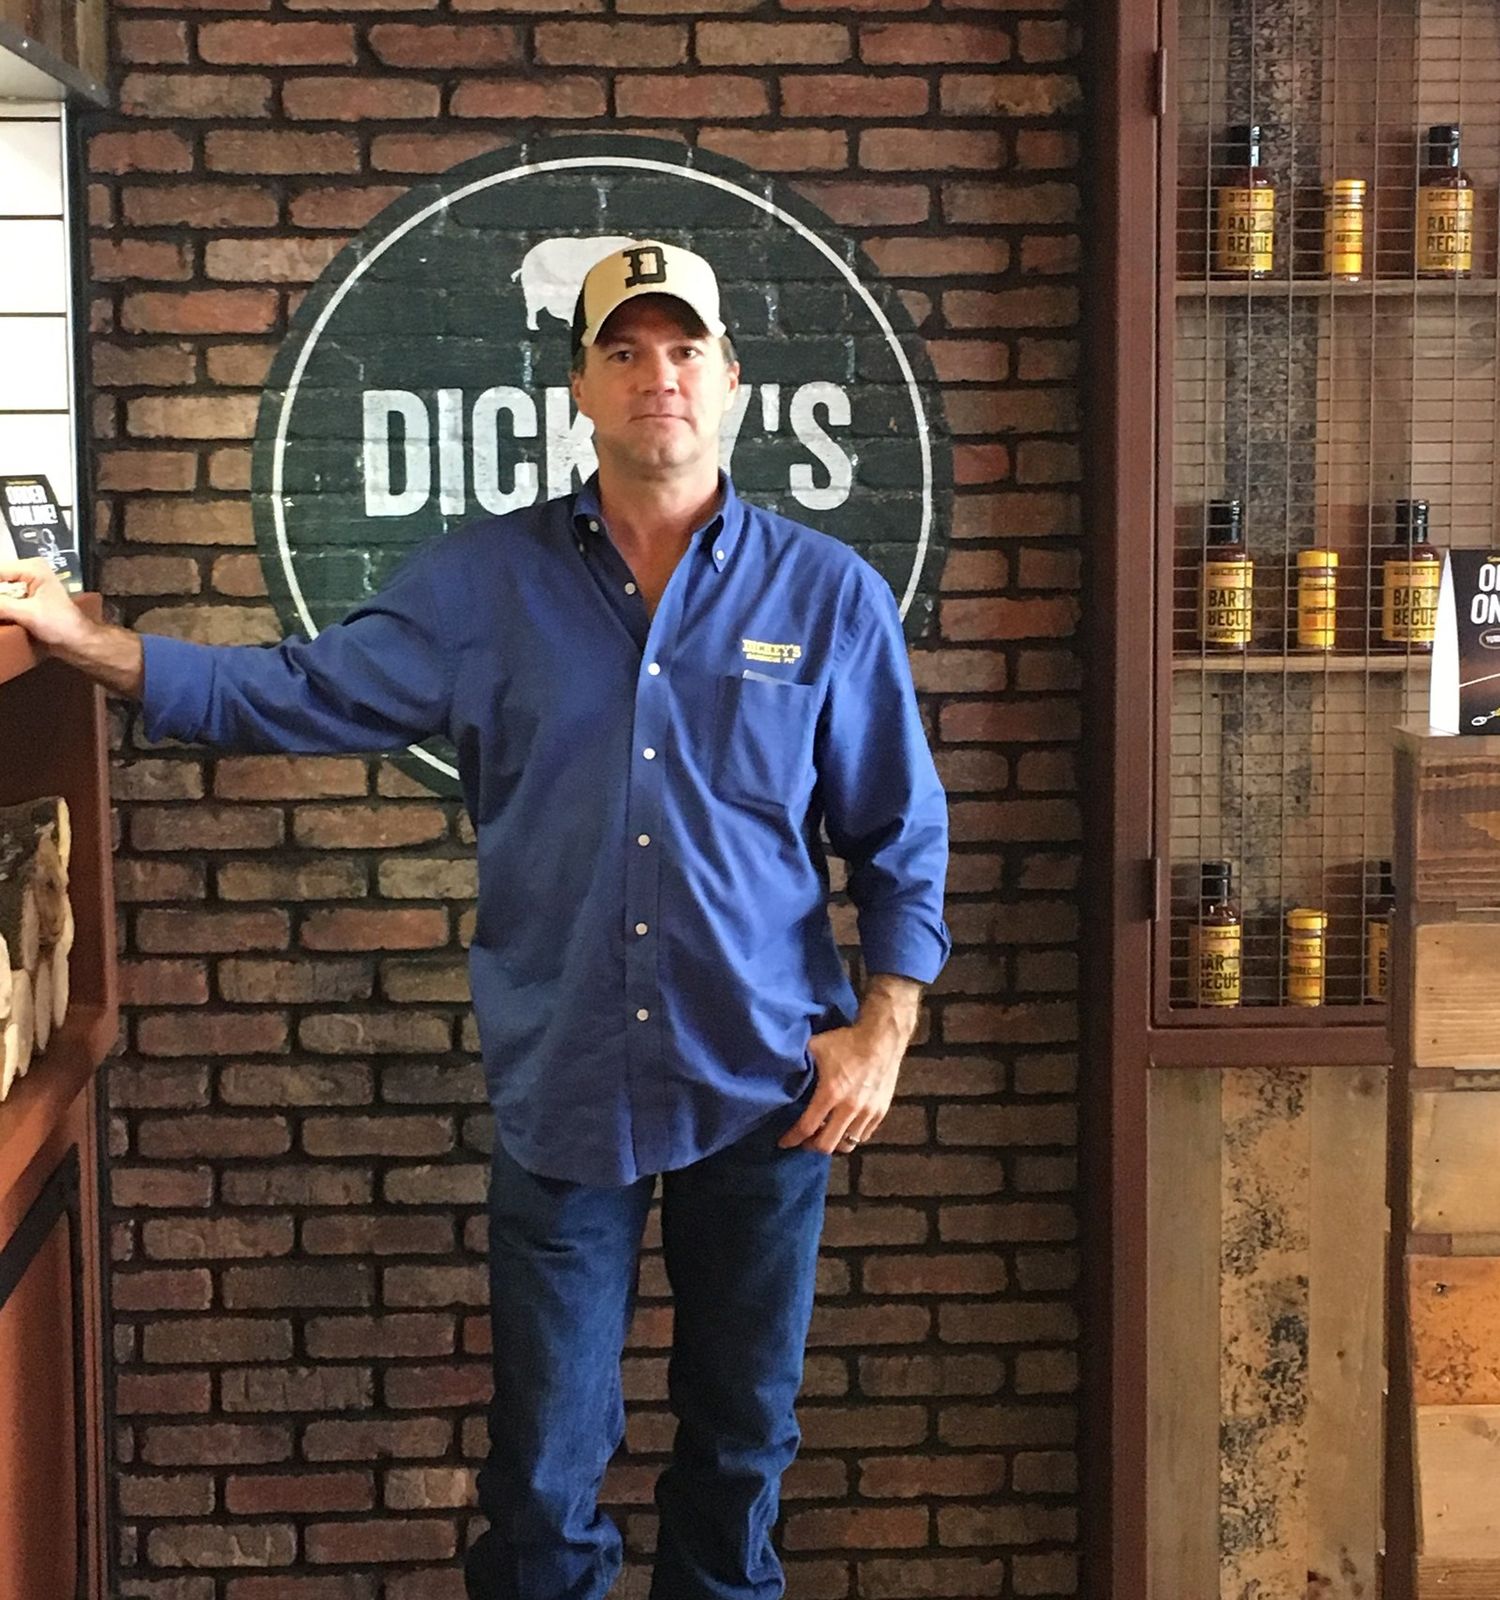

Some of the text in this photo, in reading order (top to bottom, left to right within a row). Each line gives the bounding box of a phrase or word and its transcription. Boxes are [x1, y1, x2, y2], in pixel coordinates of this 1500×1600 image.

[1427, 216, 1456, 231] BAR
[622, 246, 668, 289] D
[363, 381, 852, 517] DICK'S
[1208, 589, 1237, 607] BAR
[1393, 588, 1421, 606] BAR
[1392, 608, 1435, 626] BECUE
